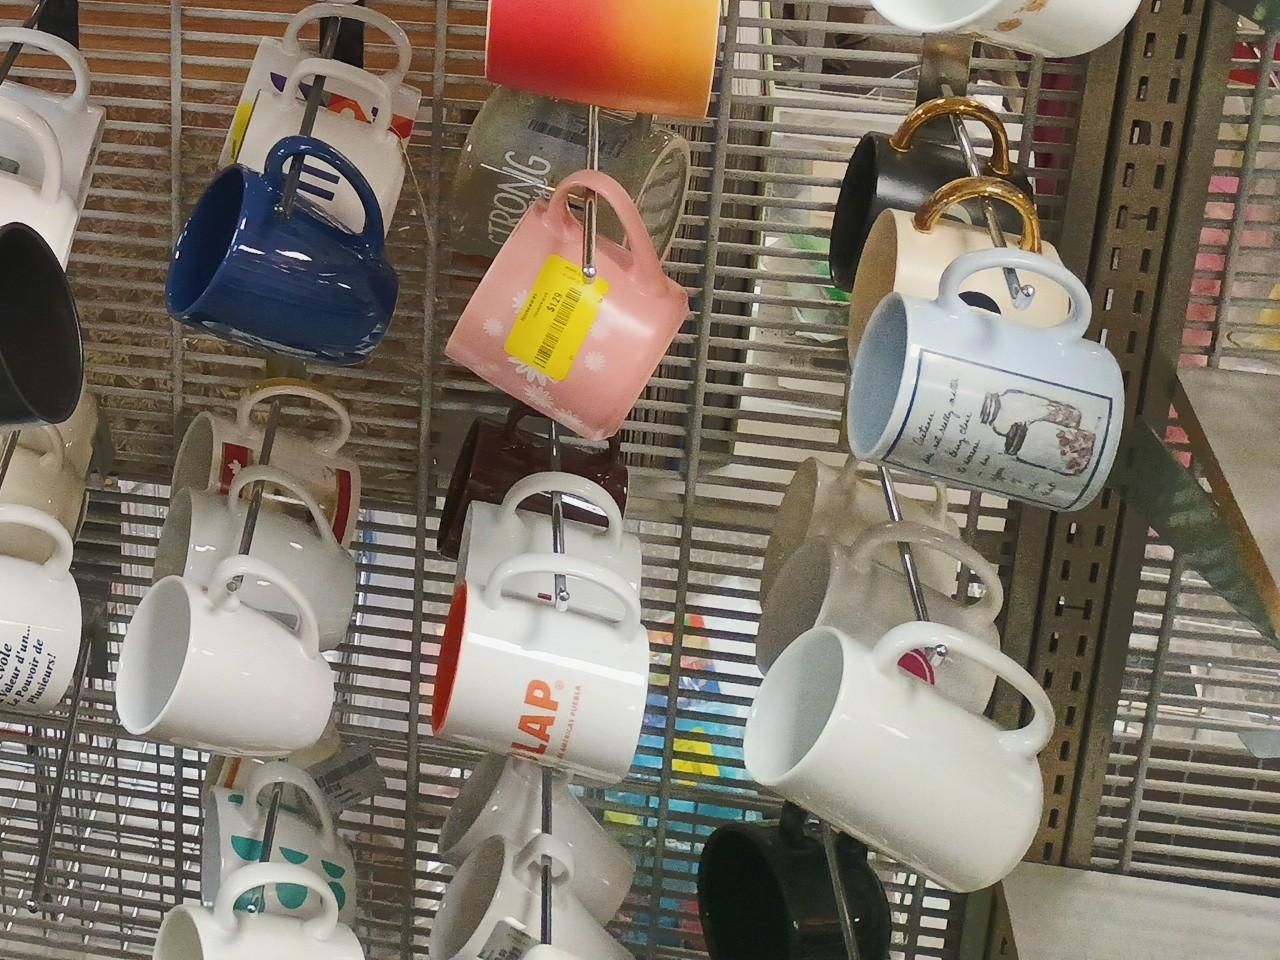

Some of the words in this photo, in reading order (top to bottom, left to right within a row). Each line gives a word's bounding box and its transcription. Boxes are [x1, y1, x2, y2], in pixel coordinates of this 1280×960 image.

[545, 291, 564, 313] $1.29
[15, 655, 40, 699] Pouvoir
[32, 638, 45, 656] de
[26, 652, 57, 705] Plusieurs!
